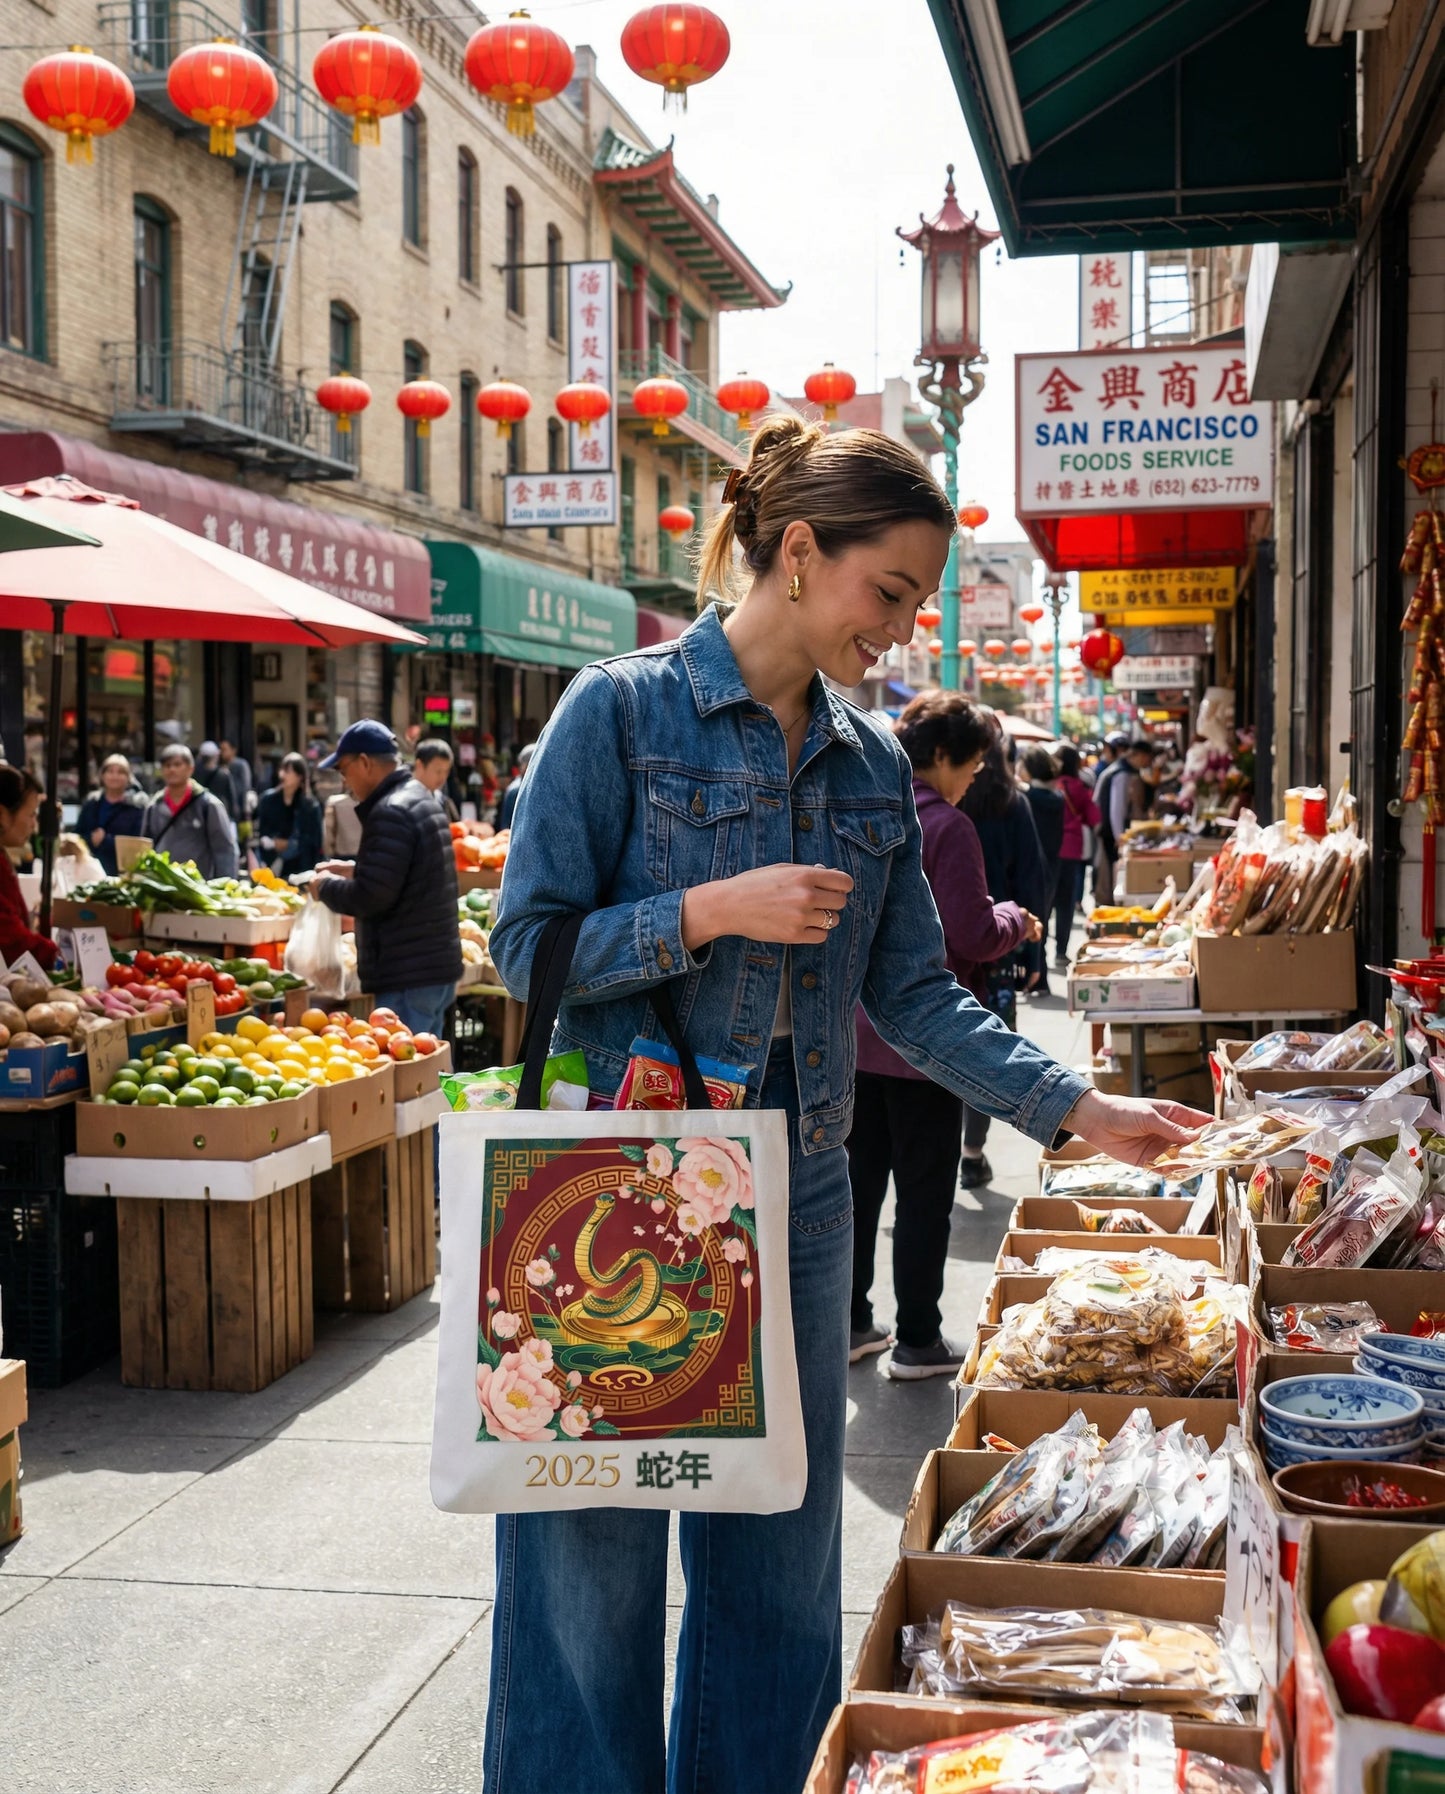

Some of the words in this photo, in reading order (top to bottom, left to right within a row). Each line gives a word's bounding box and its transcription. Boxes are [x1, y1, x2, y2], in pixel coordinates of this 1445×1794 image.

[1037, 359, 1253, 413] 金興商店
[1035, 421, 1088, 446] SAN
[1103, 414, 1259, 444] FRANCISCO
[1060, 451, 1132, 472] FOODS
[1143, 447, 1233, 470] SERVICE
[1191, 476, 1260, 494] 623-7779
[525, 1453, 621, 1487] 2025
[636, 1450, 712, 1489] 蛇年
